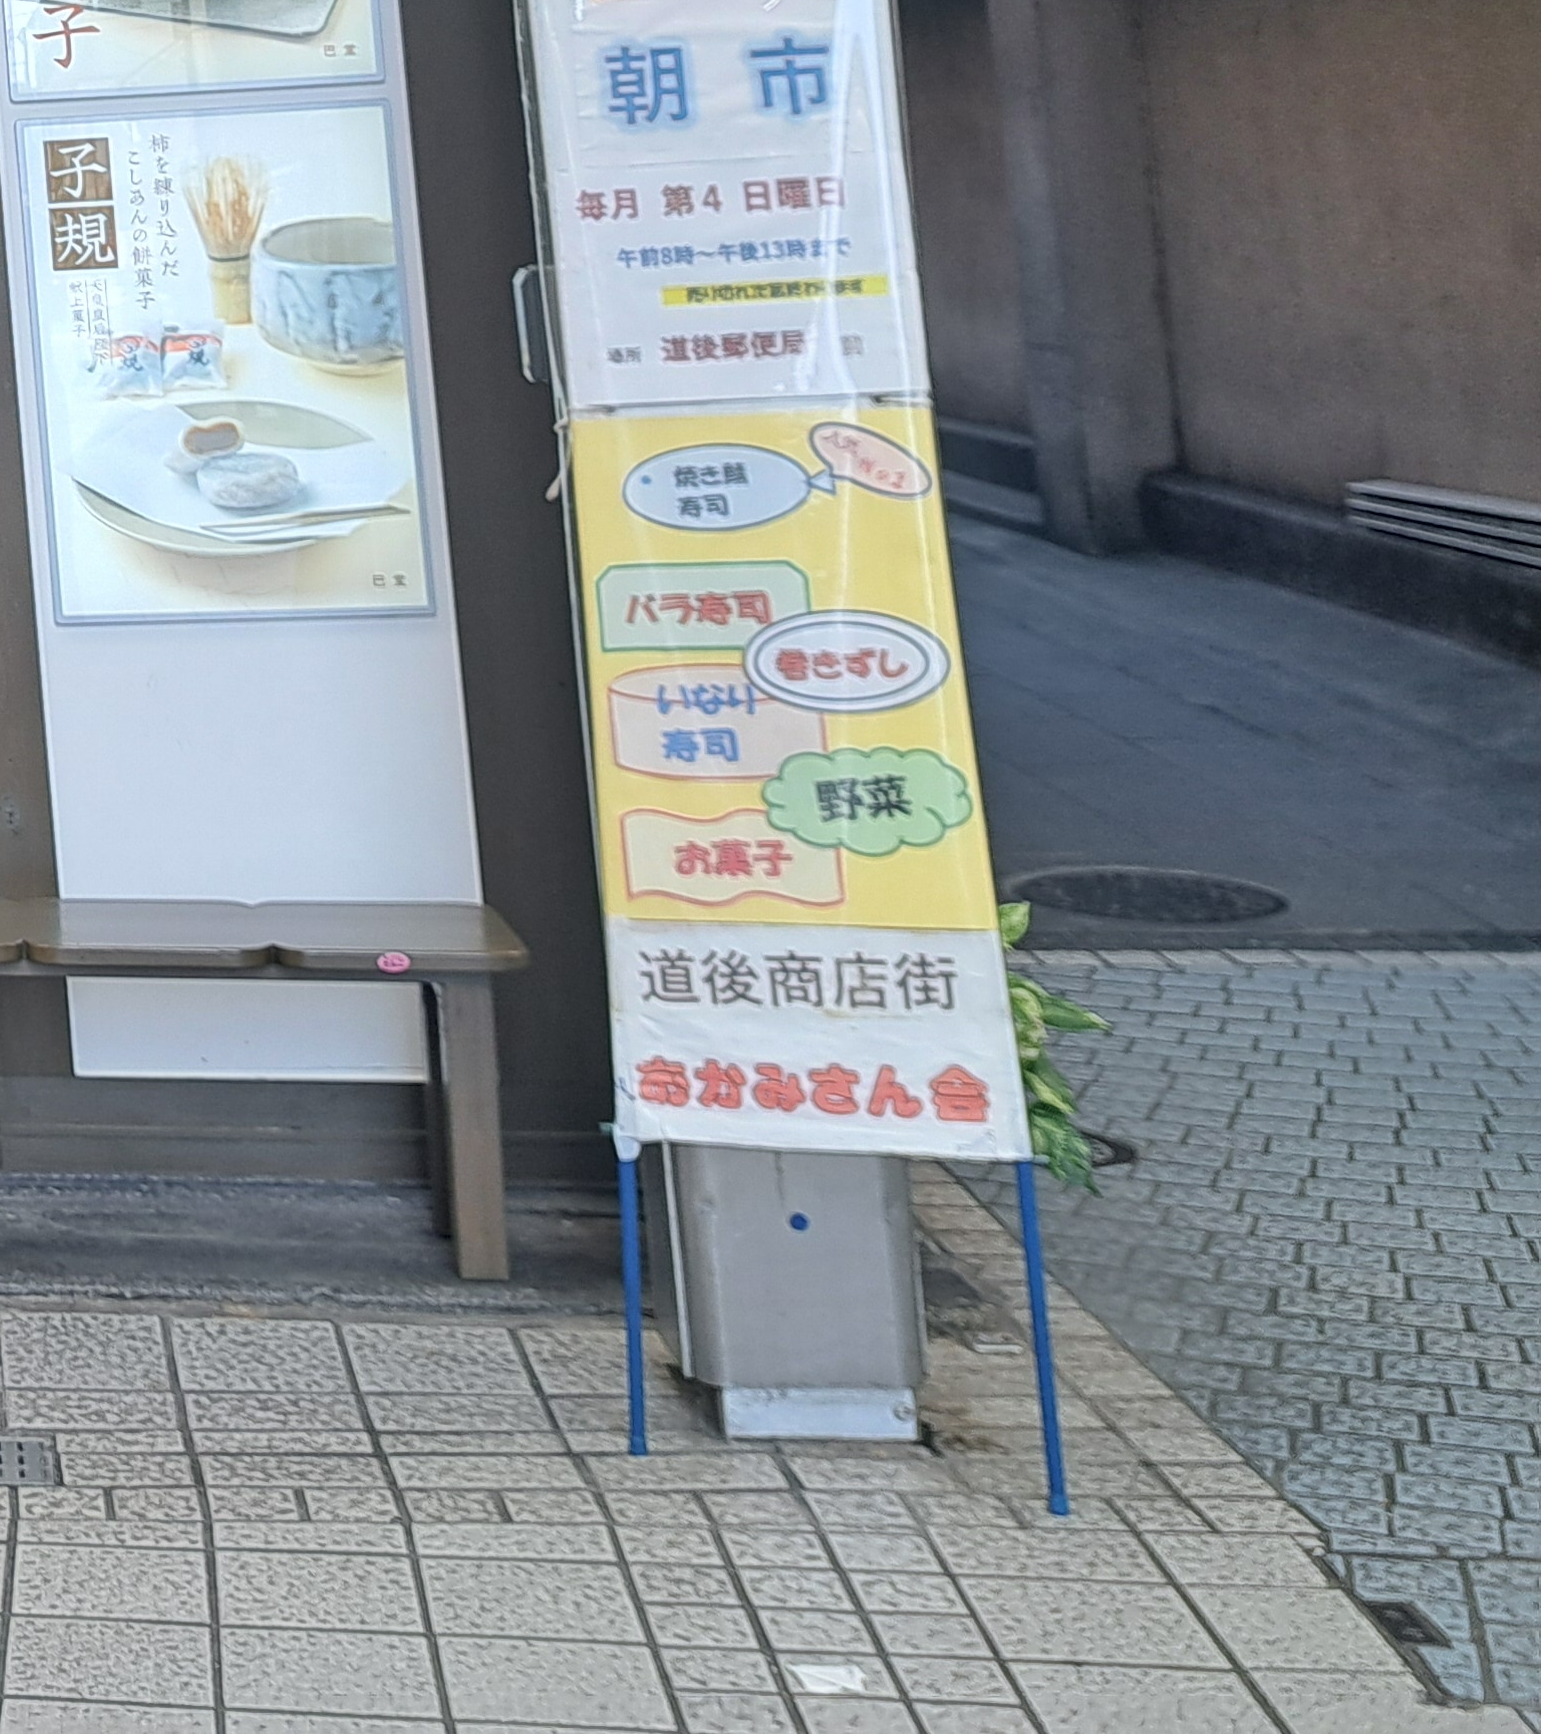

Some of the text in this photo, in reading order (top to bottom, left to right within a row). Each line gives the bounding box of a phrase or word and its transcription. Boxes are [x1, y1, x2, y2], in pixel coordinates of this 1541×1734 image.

[604, 37, 830, 125] 朝市
[48, 142, 115, 266] 子規
[148, 133, 179, 276] 柿を練り込んだ
[576, 175, 847, 221] 毎月 第4 日曜日
[678, 494, 730, 518] 寿司
[625, 591, 774, 627] バラ寿司
[656, 683, 756, 716] いなり
[661, 728, 740, 763] 寿司
[815, 775, 912, 822] 野菜
[673, 839, 792, 879] お菓子
[638, 948, 958, 1012] 道後商店街
[636, 1056, 990, 1124] おかみさん会
